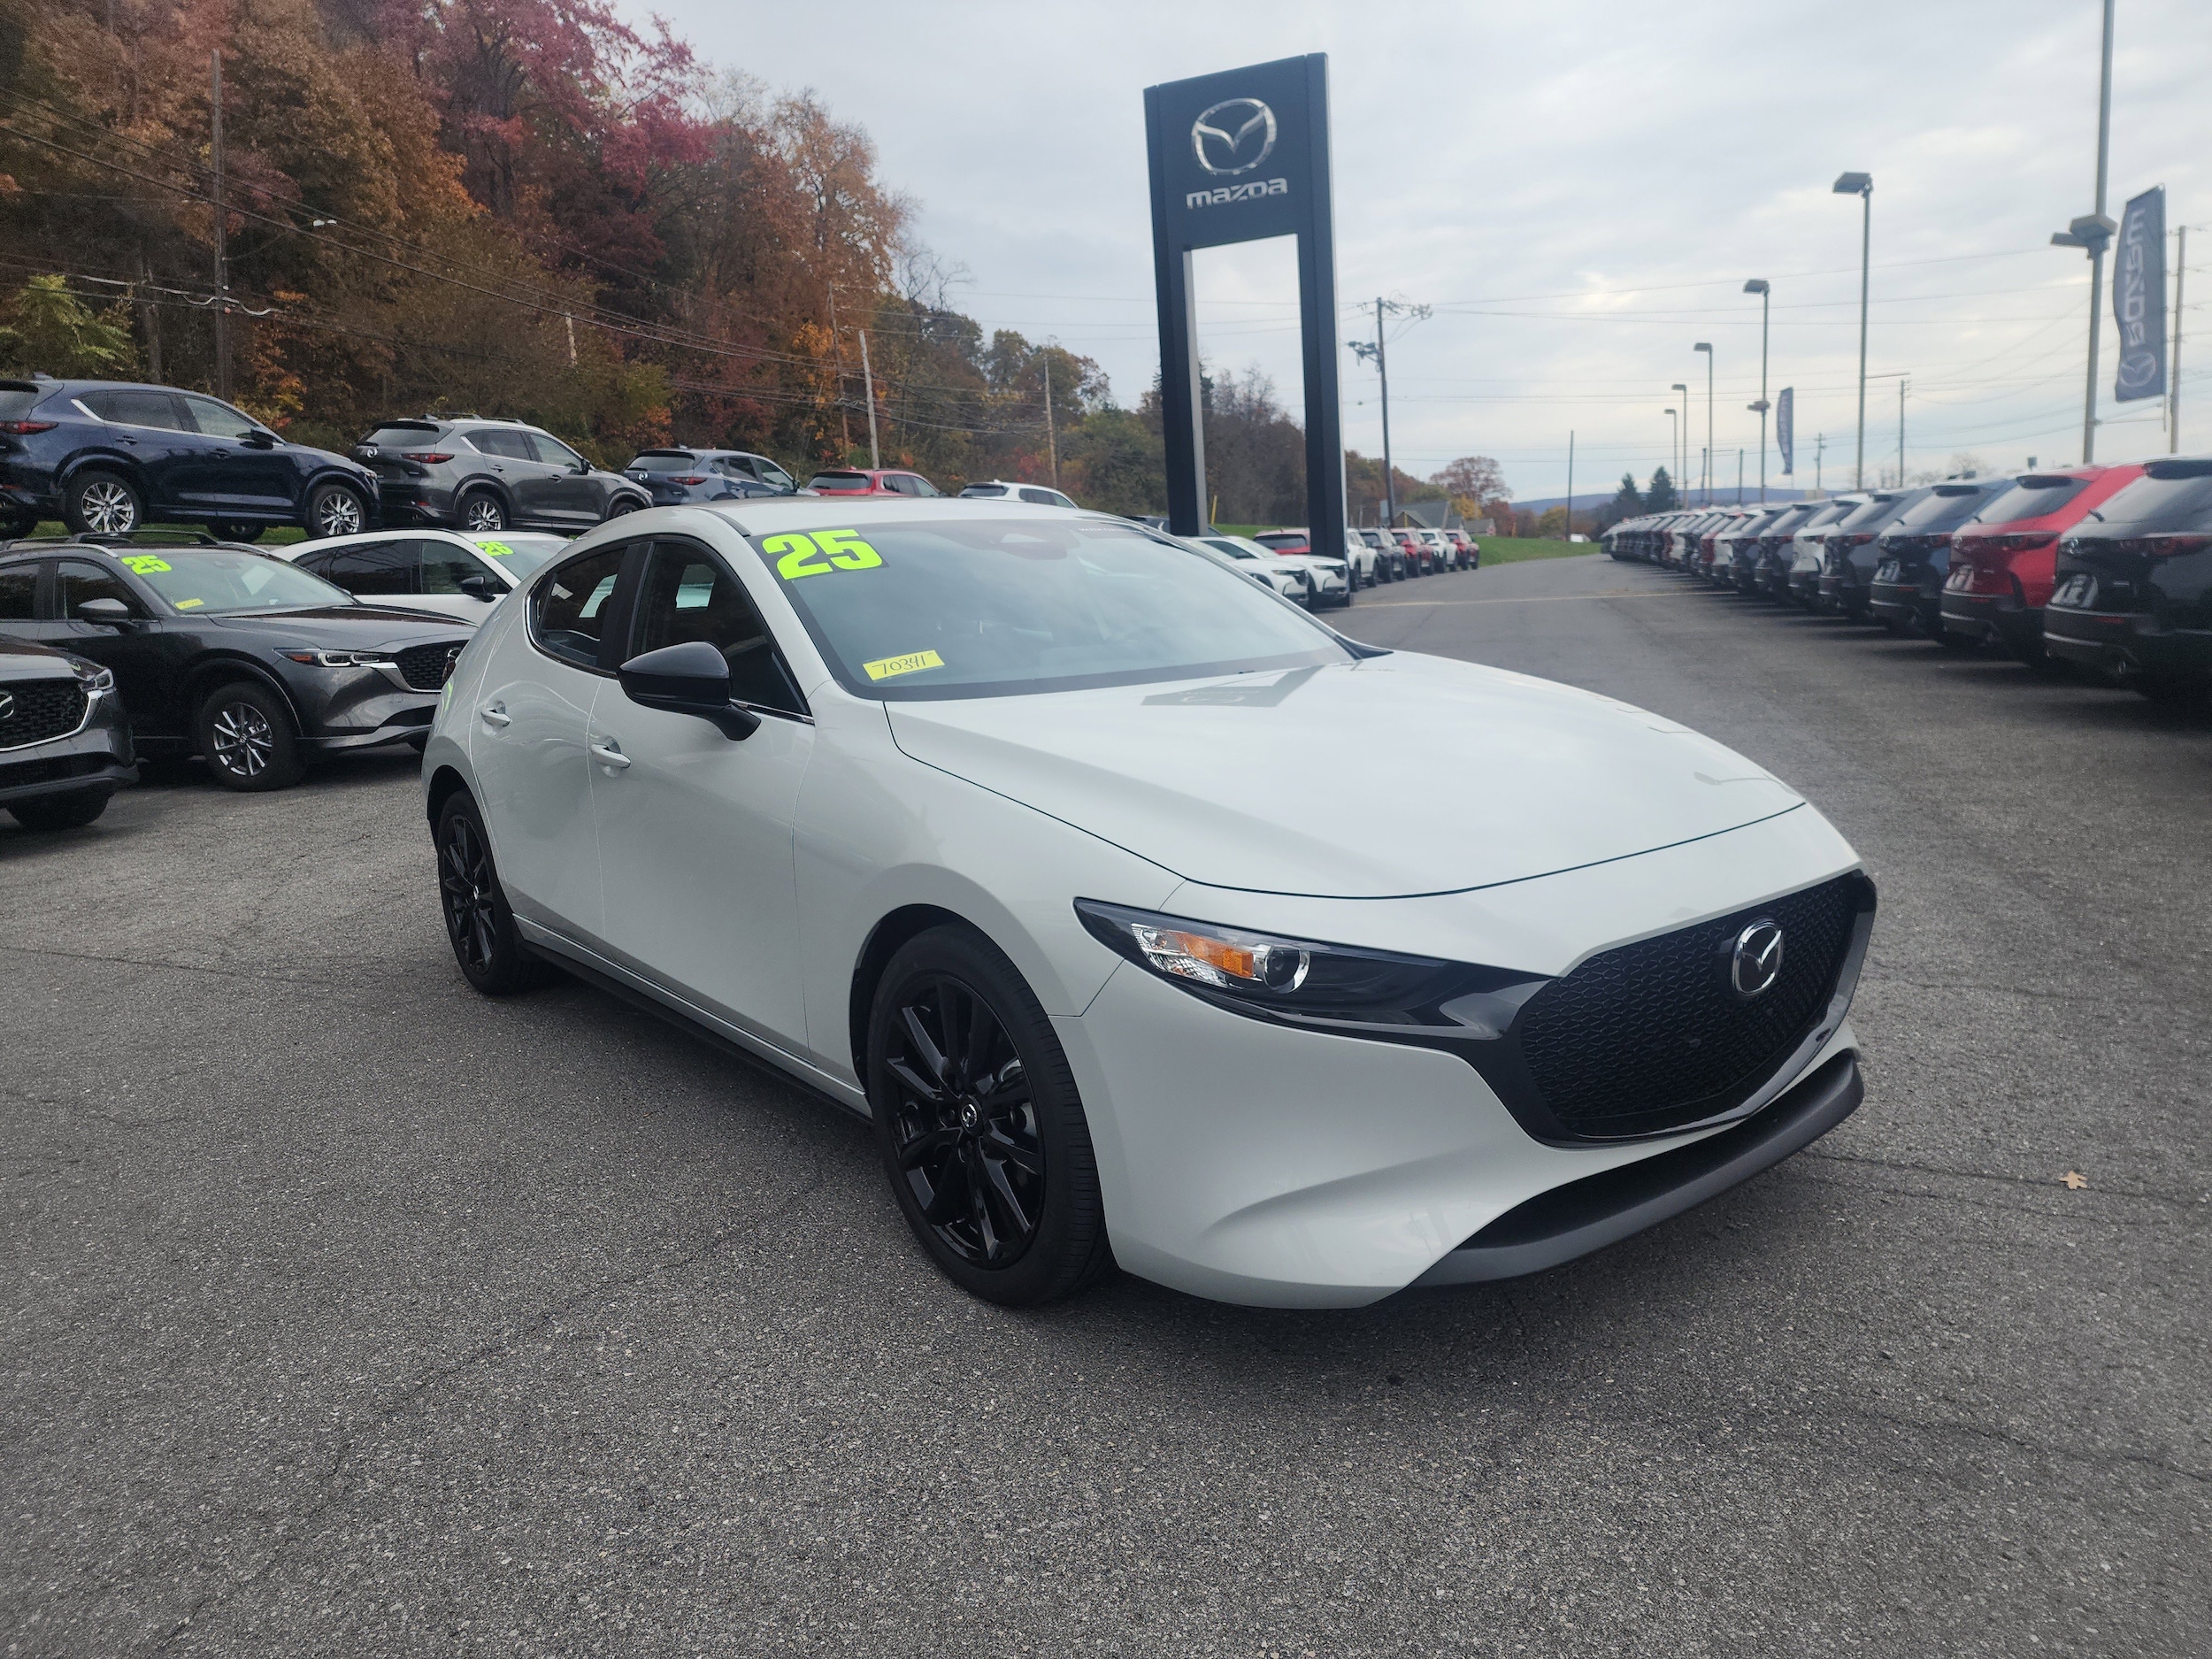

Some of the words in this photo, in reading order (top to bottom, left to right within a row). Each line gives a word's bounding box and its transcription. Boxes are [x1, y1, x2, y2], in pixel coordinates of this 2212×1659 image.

[1186, 178, 1288, 210] mazda
[475, 541, 514, 557] 26
[762, 529, 883, 580] 25
[121, 555, 173, 575] 25
[872, 655, 926, 675] 70341
